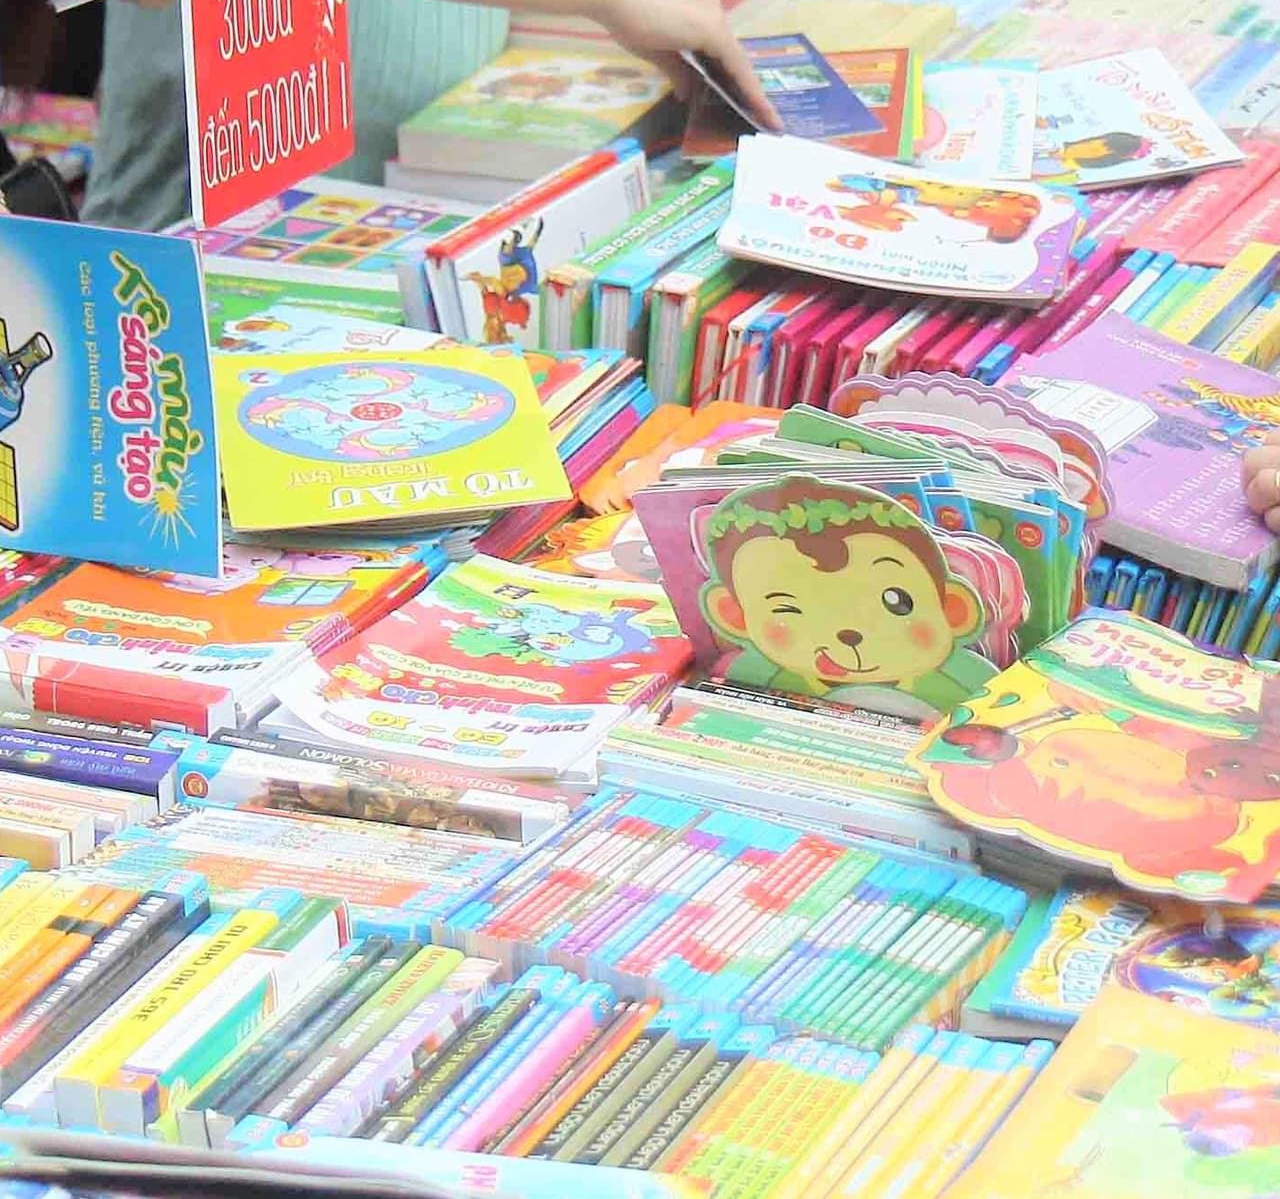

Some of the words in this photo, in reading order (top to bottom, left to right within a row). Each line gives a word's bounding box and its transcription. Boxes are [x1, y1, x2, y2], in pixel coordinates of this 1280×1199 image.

[202, 97, 244, 189] đến
[110, 313, 160, 422] sáng
[154, 355, 205, 497] màu
[118, 430, 157, 501] tạo
[327, 477, 455, 508] MÀU
[464, 468, 534, 498] TÔ
[299, 747, 390, 772] SOLOMON
[1056, 941, 1112, 1010] PETER
